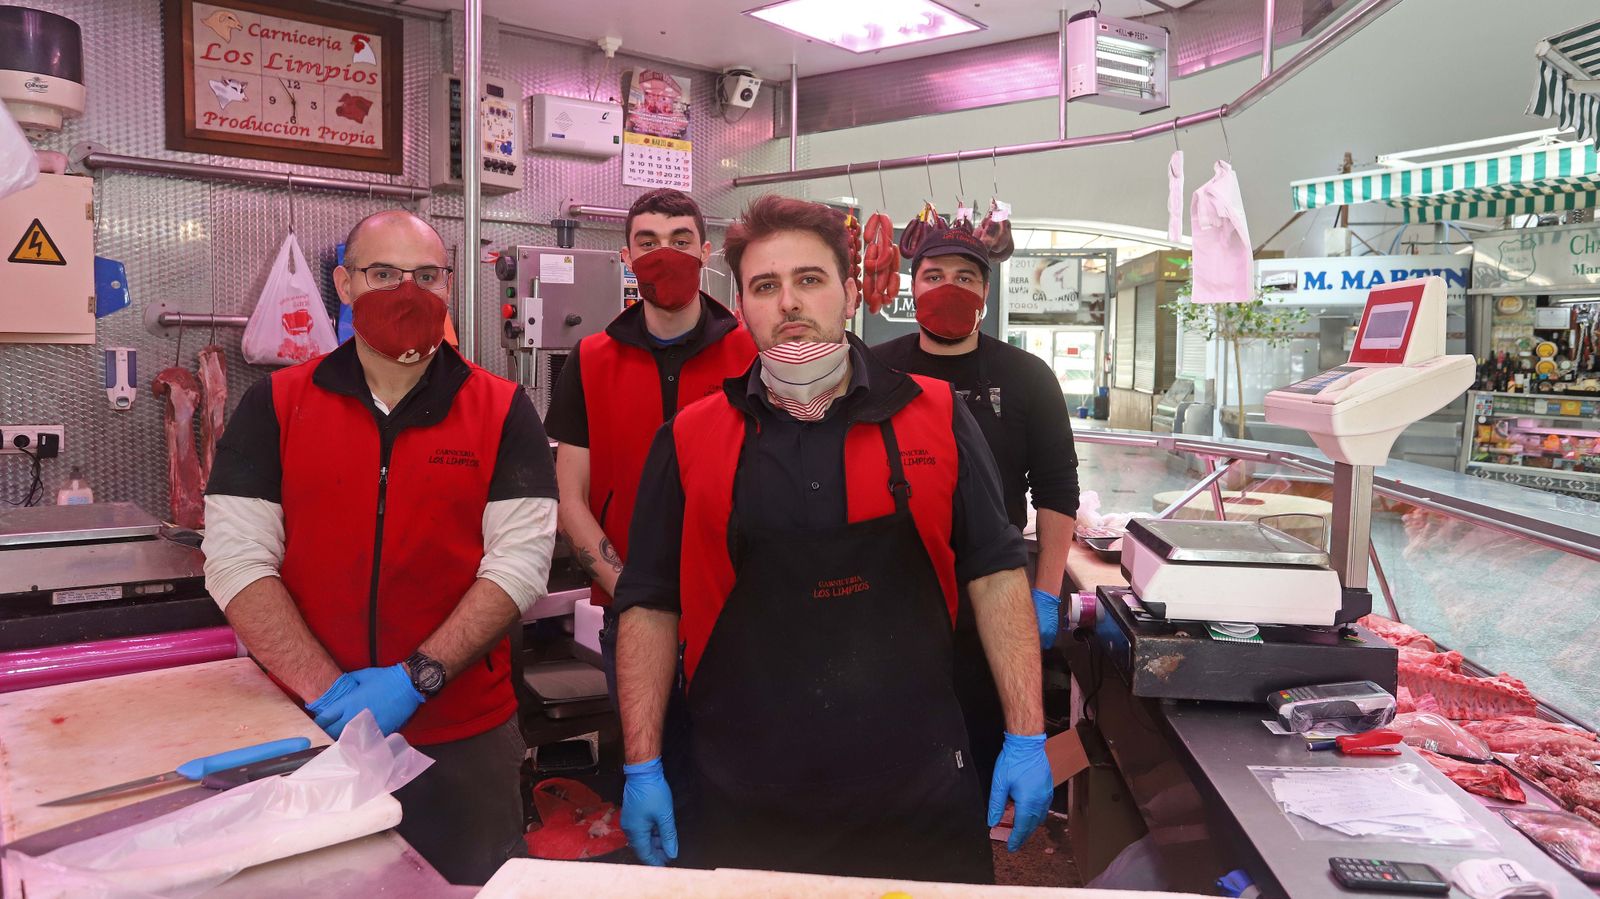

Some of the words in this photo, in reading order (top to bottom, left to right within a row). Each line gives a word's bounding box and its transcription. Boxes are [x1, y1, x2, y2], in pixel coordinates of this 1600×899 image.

[200, 42, 254, 66] Los
[263, 52, 378, 85] Limpios
[287, 79, 301, 90] 12
[269, 96, 277, 105] 9
[311, 101, 318, 110] 3
[290, 115, 297, 125] 6
[317, 126, 376, 146] Propia
[1573, 263, 1600, 275] Mar
[1303, 271, 1333, 290] M.
[813, 588, 831, 598] LOS
[833, 582, 870, 597] LIMPIOS
